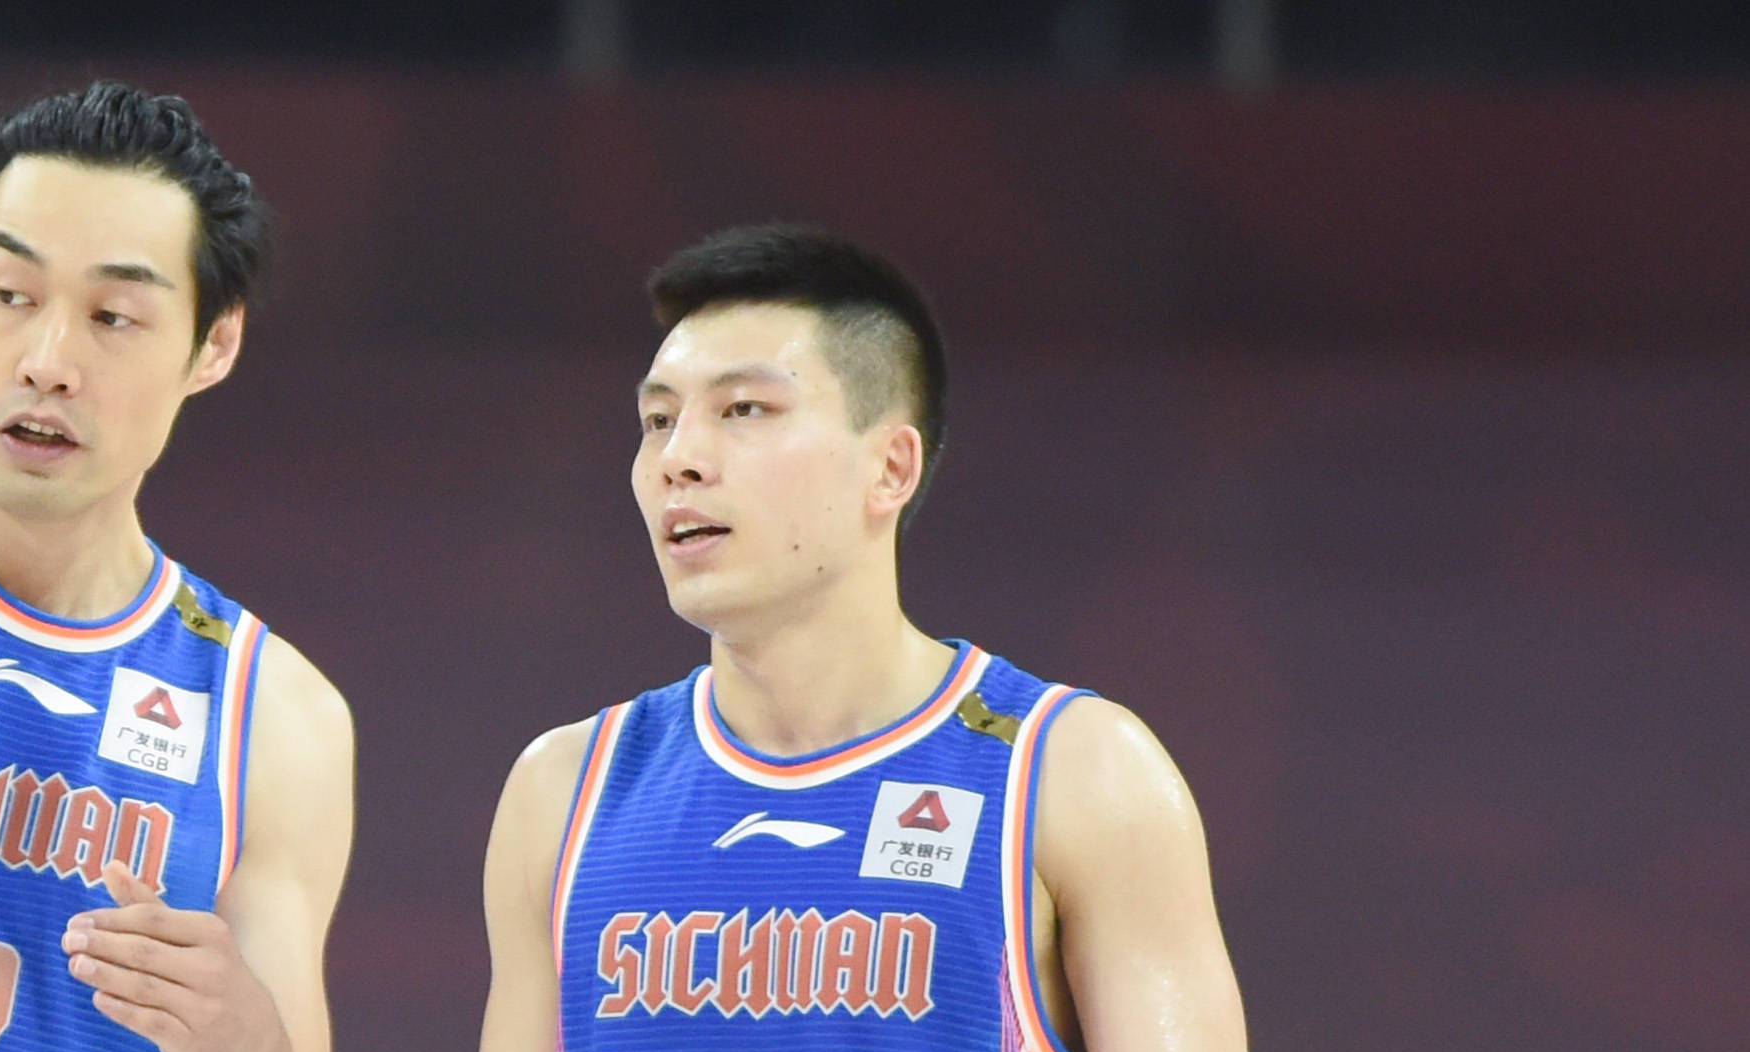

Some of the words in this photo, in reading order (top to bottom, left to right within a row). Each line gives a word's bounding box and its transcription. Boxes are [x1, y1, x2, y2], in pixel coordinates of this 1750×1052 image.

[117, 727, 187, 758] 广发银行
[127, 748, 170, 772] CGB
[879, 840, 954, 861] 广发银行
[890, 859, 934, 878] CGB
[595, 907, 937, 1022] SICHUAN
